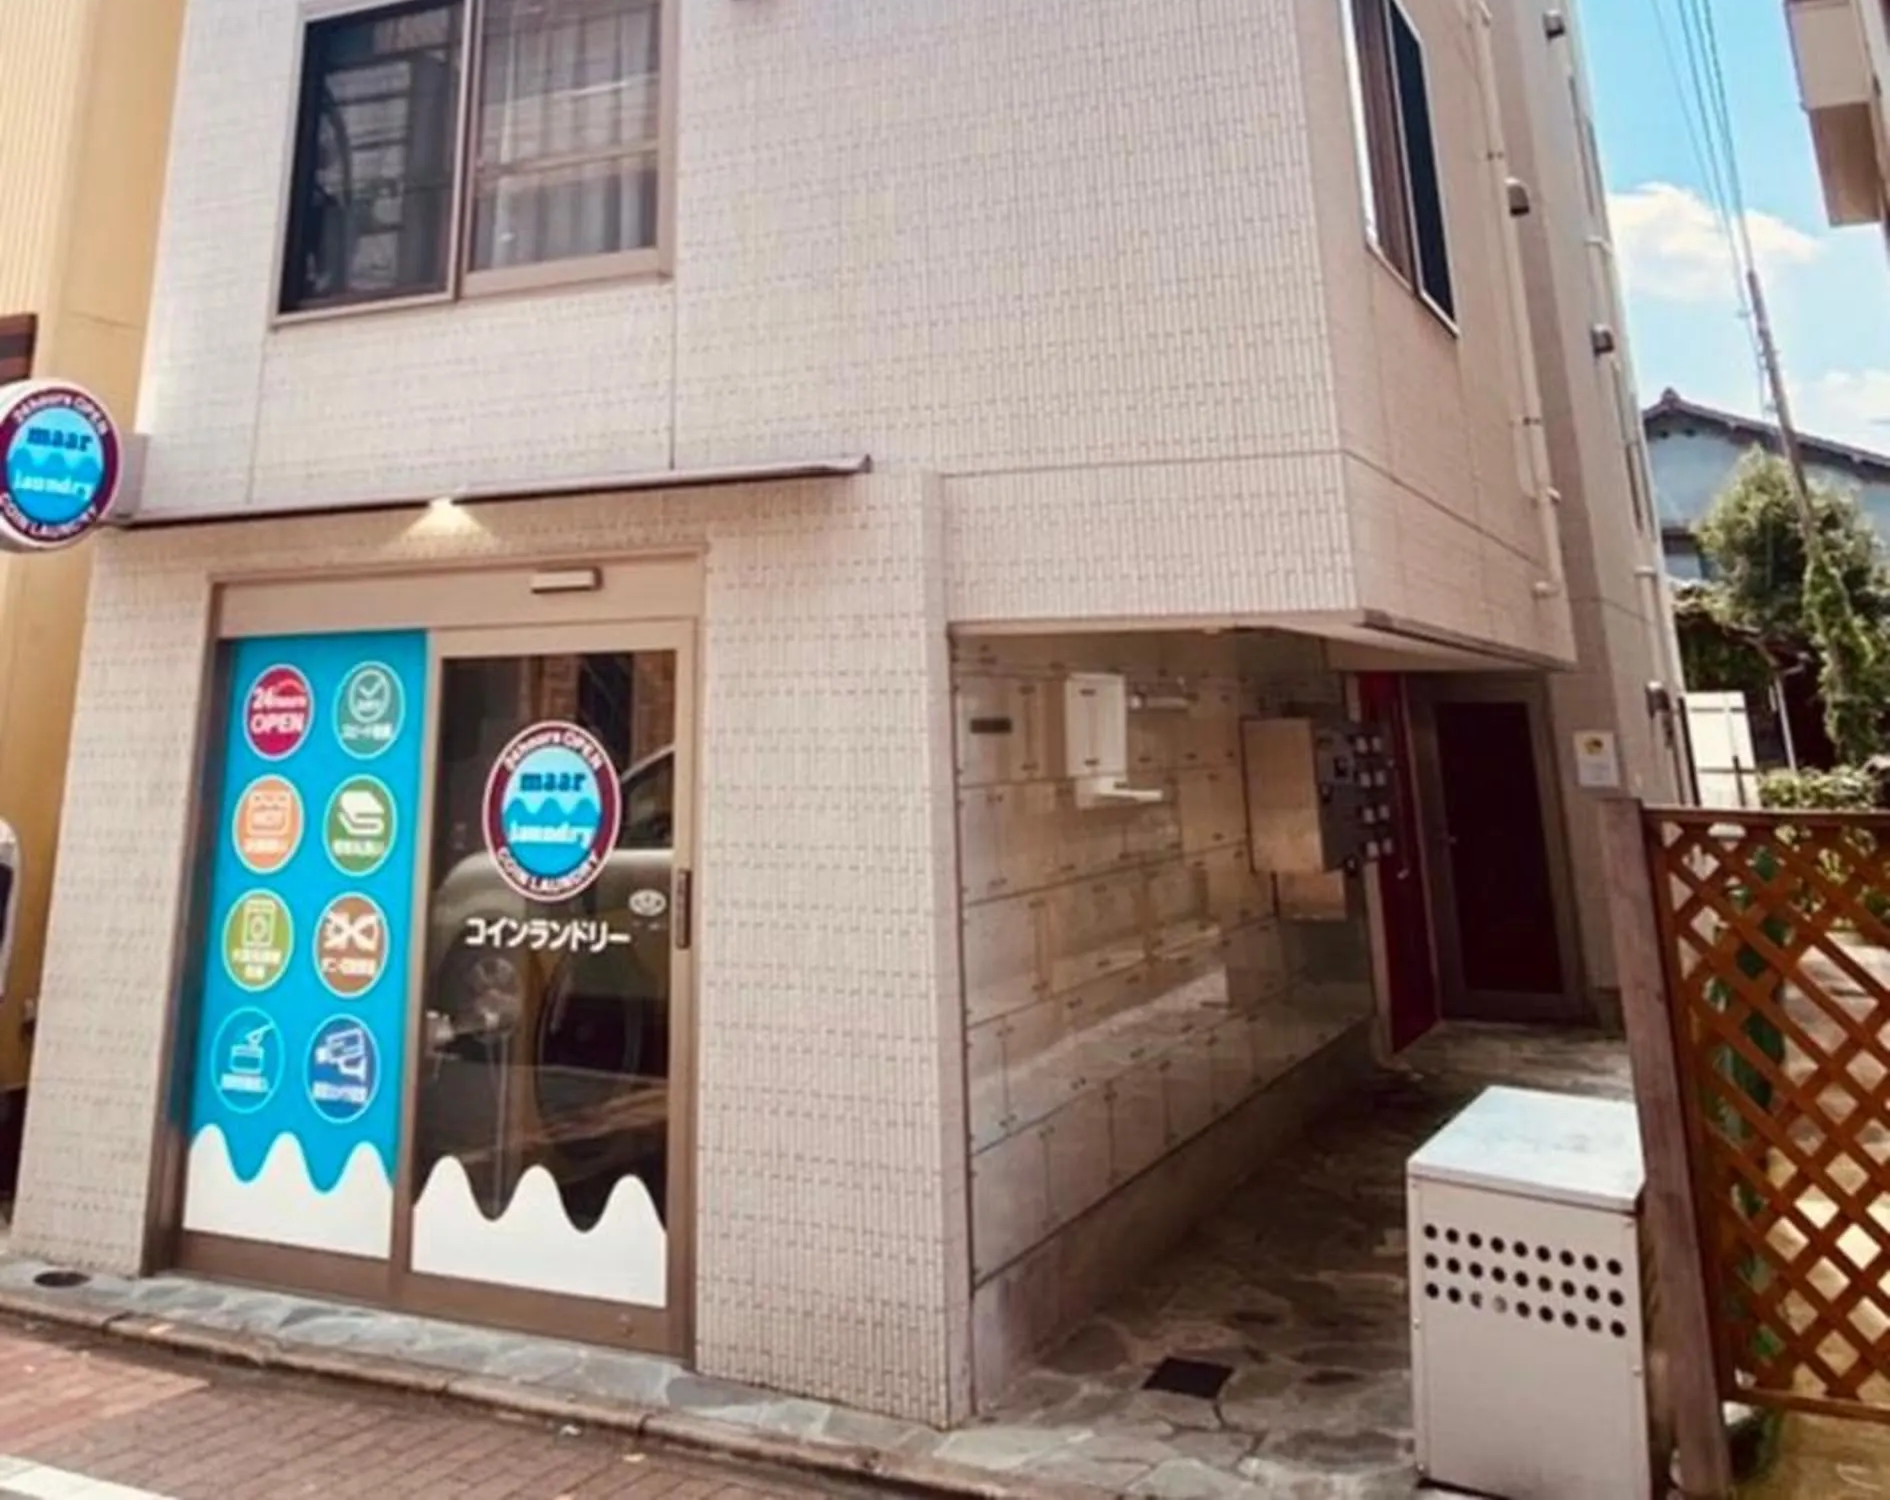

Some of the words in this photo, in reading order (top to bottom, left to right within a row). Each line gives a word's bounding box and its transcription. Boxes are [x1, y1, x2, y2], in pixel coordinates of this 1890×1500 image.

[26, 427, 93, 452] maar
[14, 469, 96, 502] laundry
[250, 712, 305, 735] OPEN
[563, 731, 603, 770] OPEN
[519, 772, 587, 792] maar
[510, 819, 594, 850] laundry
[464, 916, 631, 953] コインランドリー
